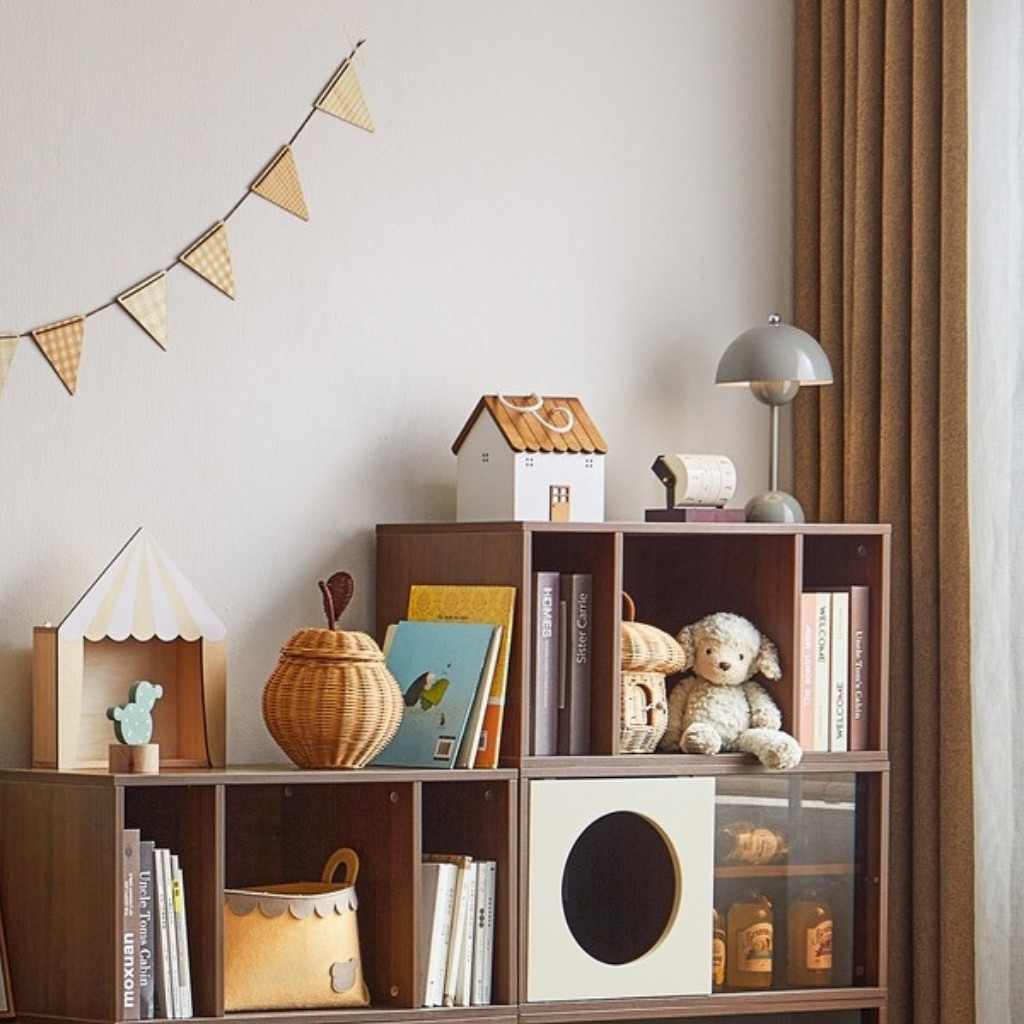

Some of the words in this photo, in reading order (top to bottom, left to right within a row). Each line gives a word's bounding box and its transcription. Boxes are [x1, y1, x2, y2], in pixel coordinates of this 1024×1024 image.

[577, 593, 588, 628] Carrie
[577, 631, 588, 664] Sister
[818, 606, 826, 663] WELCOME
[836, 682, 844, 740] WELCOME
[139, 871, 151, 908] Uncle
[124, 933, 135, 1008] moxuan
[139, 948, 151, 986] Cabin
